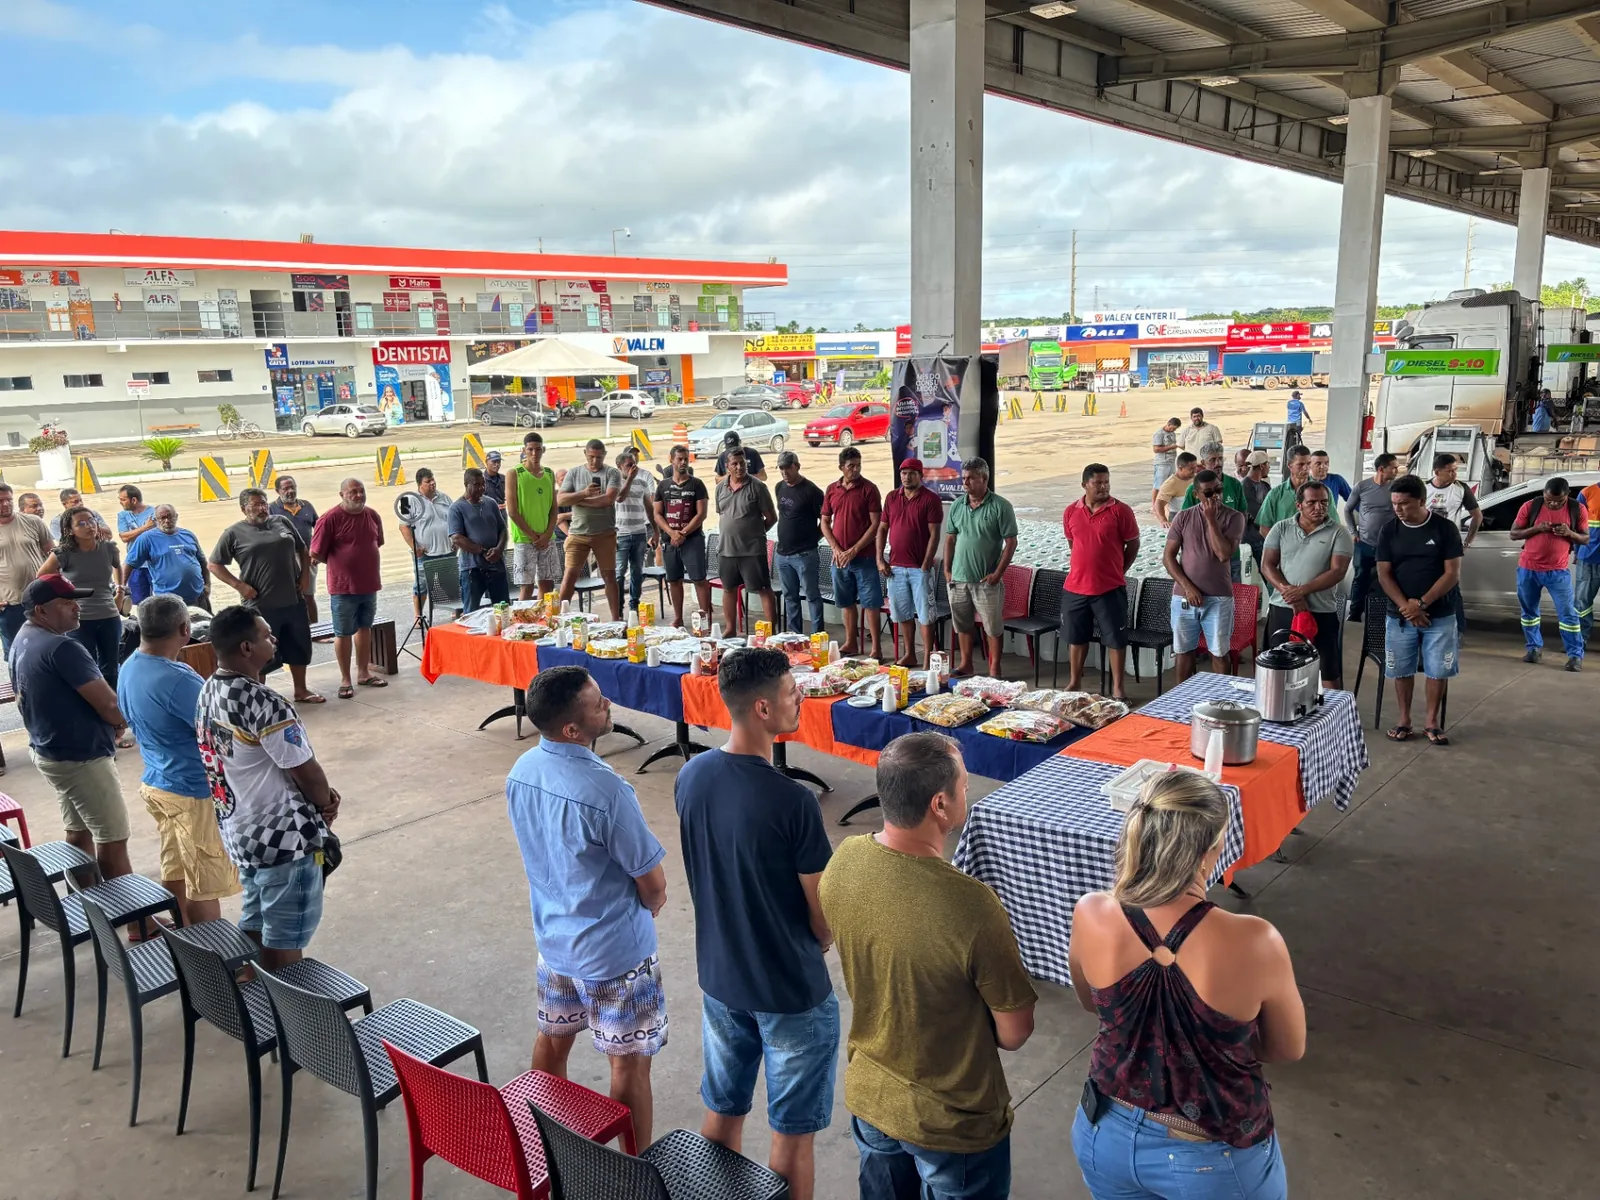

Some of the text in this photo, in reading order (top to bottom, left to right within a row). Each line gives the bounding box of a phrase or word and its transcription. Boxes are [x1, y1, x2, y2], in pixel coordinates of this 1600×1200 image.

[144, 270, 178, 281] ALFA
[409, 280, 431, 288] Mafro
[147, 295, 176, 304] ALFA
[1105, 311, 1177, 322] VALEN CENTER II
[626, 338, 665, 352] VALEN
[377, 346, 449, 362] DENTISTA
[1255, 364, 1287, 374] ARLA
[1448, 358, 1485, 369] S-10
